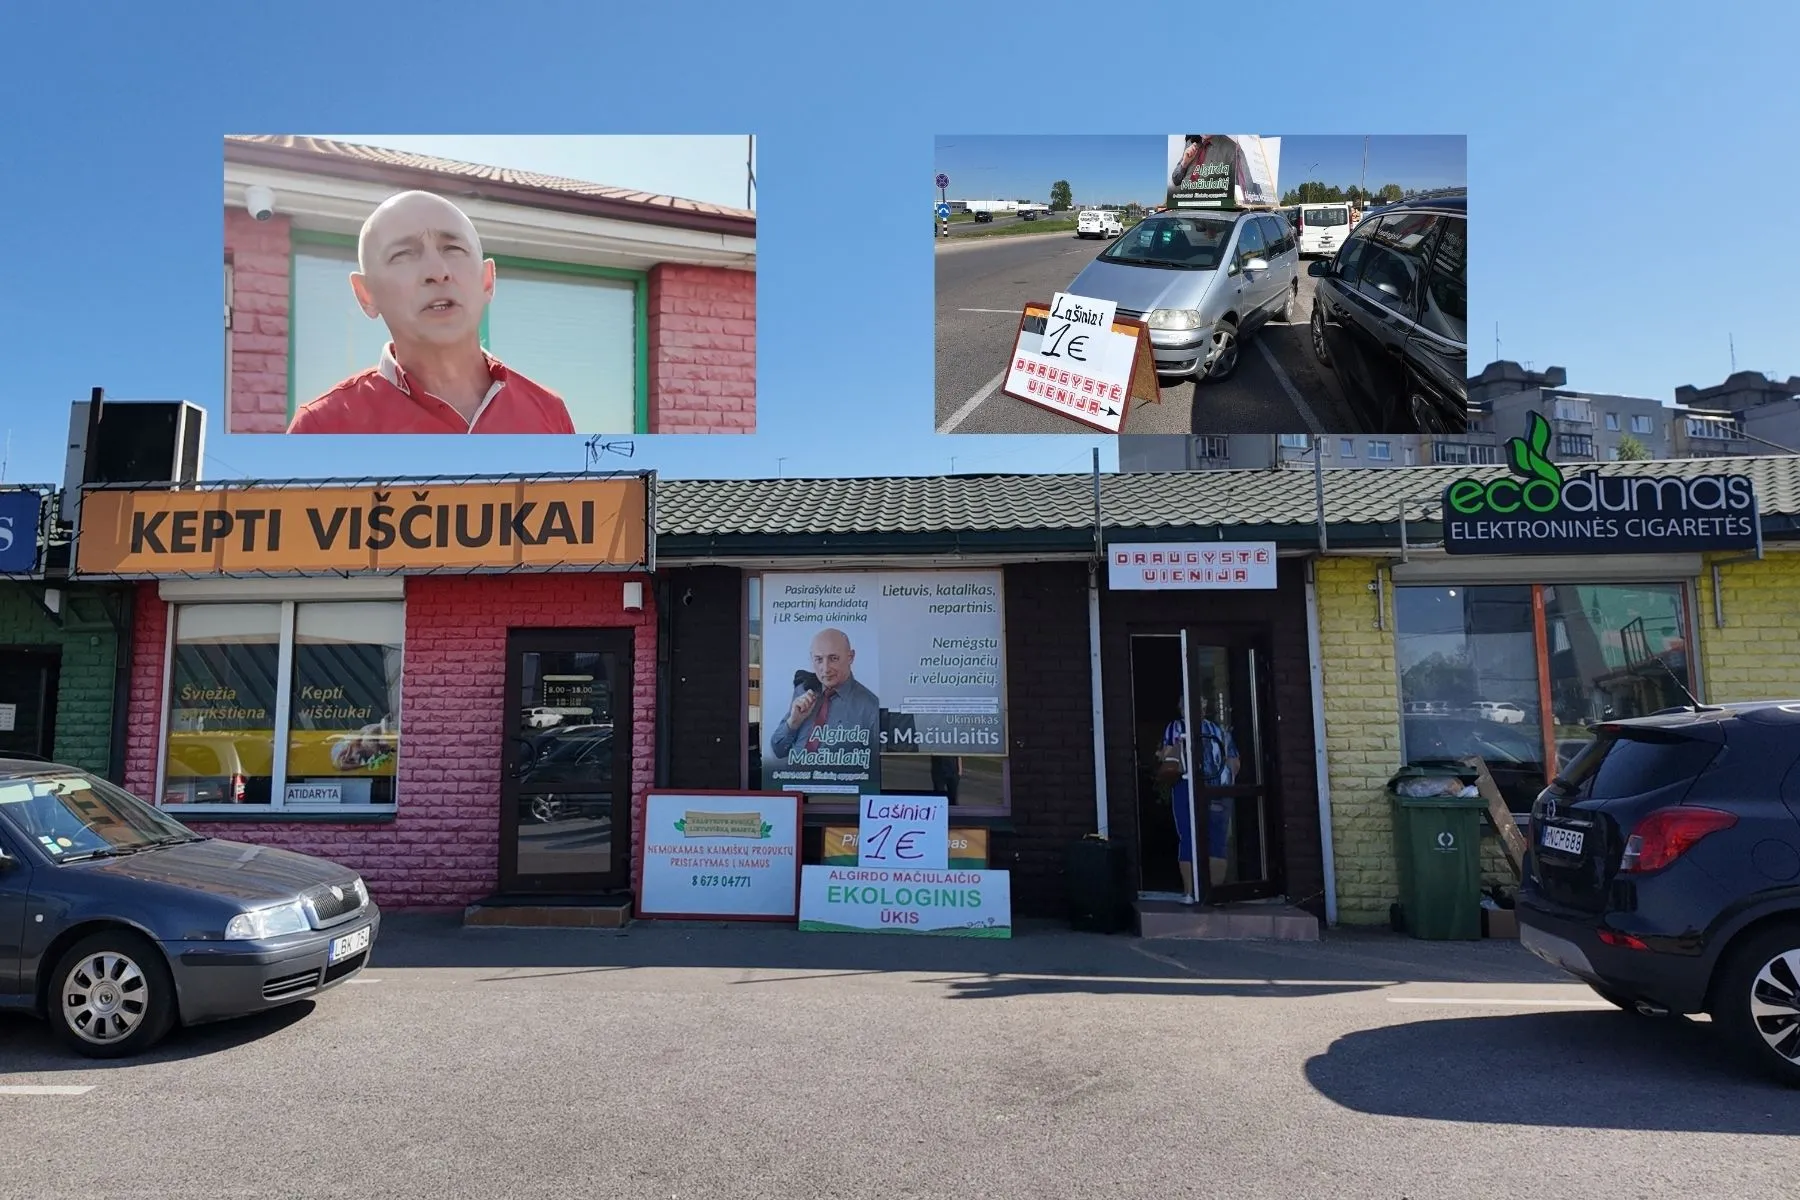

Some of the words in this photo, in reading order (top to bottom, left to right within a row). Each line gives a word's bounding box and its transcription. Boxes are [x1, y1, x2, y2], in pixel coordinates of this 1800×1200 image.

[1015, 358, 1122, 403] DRAUGYSTĖ
[1450, 472, 1750, 513] ecodumas
[130, 508, 282, 554] KEPTI
[306, 491, 595, 552] VIŠČIUKAI
[1451, 517, 1619, 539] ELEKTRONINĖS
[1625, 514, 1752, 537] CIGARETĖS
[1115, 548, 1269, 565] DRAUGYSTĖ
[785, 585, 842, 595] Pasirašykite
[845, 584, 856, 594] už
[882, 584, 932, 597] Lietuvis,
[936, 583, 996, 597] katalikas,
[772, 599, 817, 610] nepartinį
[819, 599, 868, 610] kandidatą
[929, 601, 996, 615] nepartinis.
[779, 613, 791, 622] LR
[794, 612, 823, 624] Seimą
[825, 612, 868, 623] ūkininką
[933, 636, 998, 651] Nemėgstu
[920, 654, 998, 668] meluojančių
[909, 672, 918, 684] ir
[922, 672, 998, 688] vėluojančių.
[181, 685, 236, 700] Šviežia
[301, 686, 343, 701] Kepti
[300, 705, 372, 719] viščiukai
[810, 725, 870, 745] Algirdą
[894, 727, 999, 745] Mačiulaitis
[788, 748, 870, 769] Mačiulaitį
[288, 788, 339, 799] ATIDARYTA
[866, 799, 938, 821] Lašiniai
[648, 845, 704, 854] NEMOKAMAS
[670, 858, 729, 868] PRISTATYMAS
[739, 859, 771, 868] NAMUS
[692, 875, 698, 887] 8
[701, 876, 719, 887] 673
[829, 870, 889, 882] ALGIRDO
[893, 870, 982, 885] MAČIULAIČIO
[828, 886, 982, 908] EKOLOGINIS
[881, 910, 920, 924] ŪKIS
